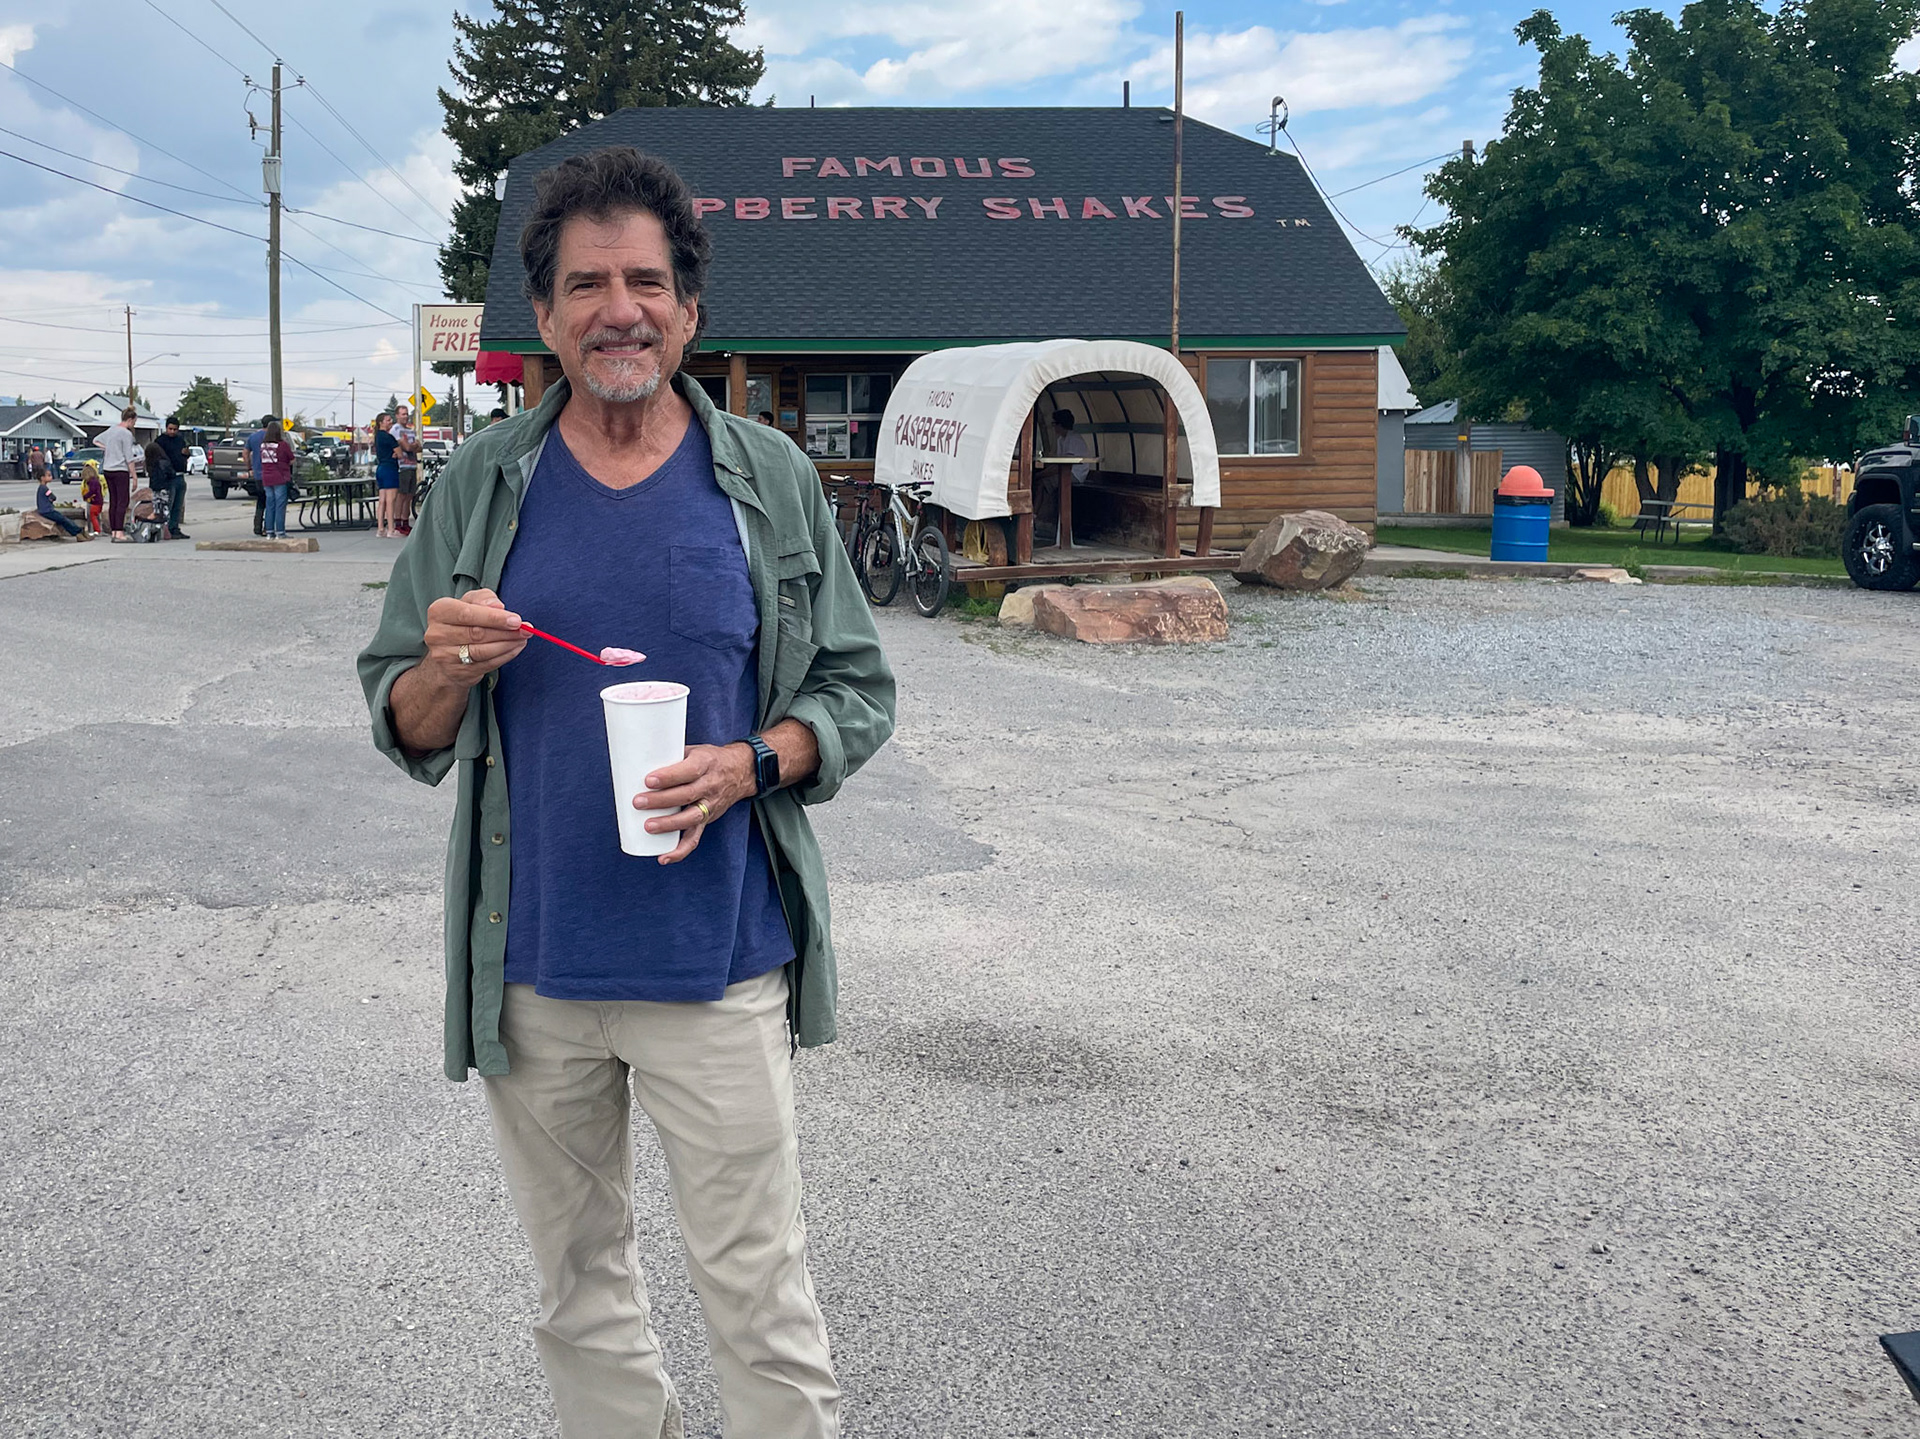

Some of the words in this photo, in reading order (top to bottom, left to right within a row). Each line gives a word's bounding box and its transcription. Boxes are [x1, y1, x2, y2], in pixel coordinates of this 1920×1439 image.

[781, 156, 1036, 178] FAMOUS
[982, 196, 1255, 220] SHAKES
[429, 314, 468, 328] Home
[432, 331, 480, 352] FRIE
[894, 413, 968, 458] RASPBERRY
